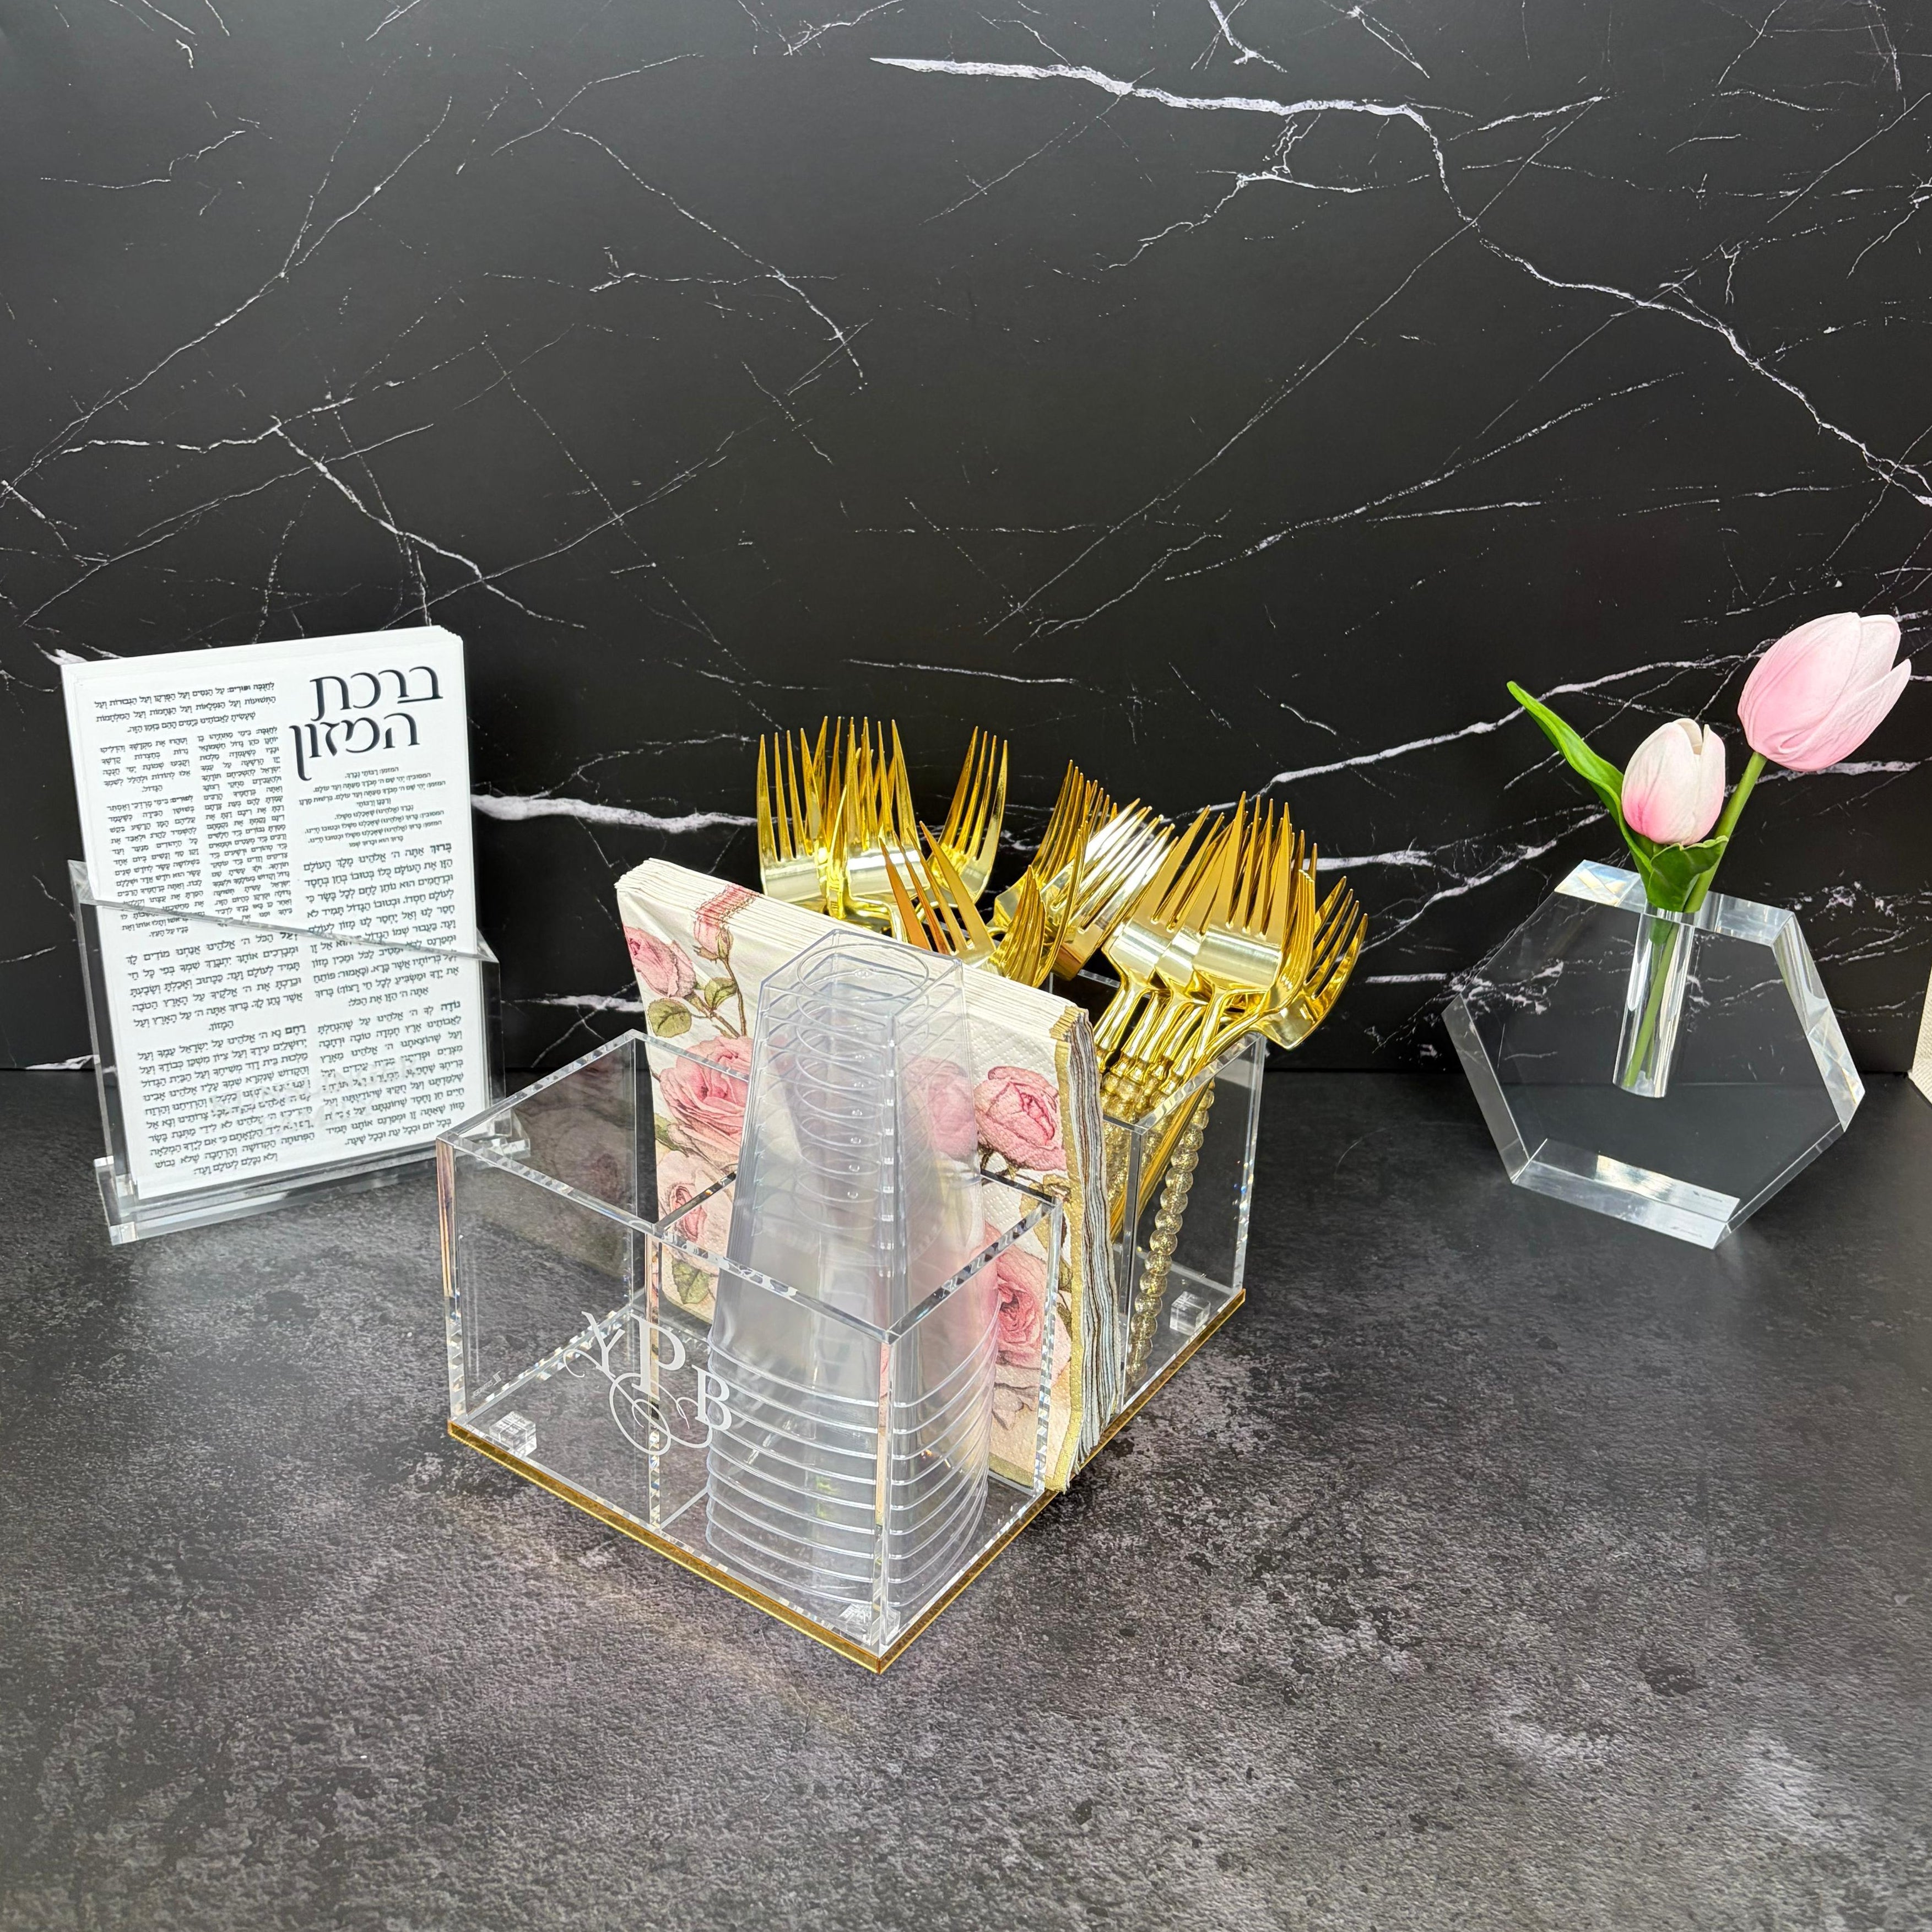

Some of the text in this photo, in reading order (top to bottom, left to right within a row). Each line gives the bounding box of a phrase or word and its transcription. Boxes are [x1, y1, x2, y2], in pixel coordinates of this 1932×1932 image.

[310, 666, 443, 721] ברכת
[289, 713, 420, 781] המזון
[279, 932, 297, 940] על
